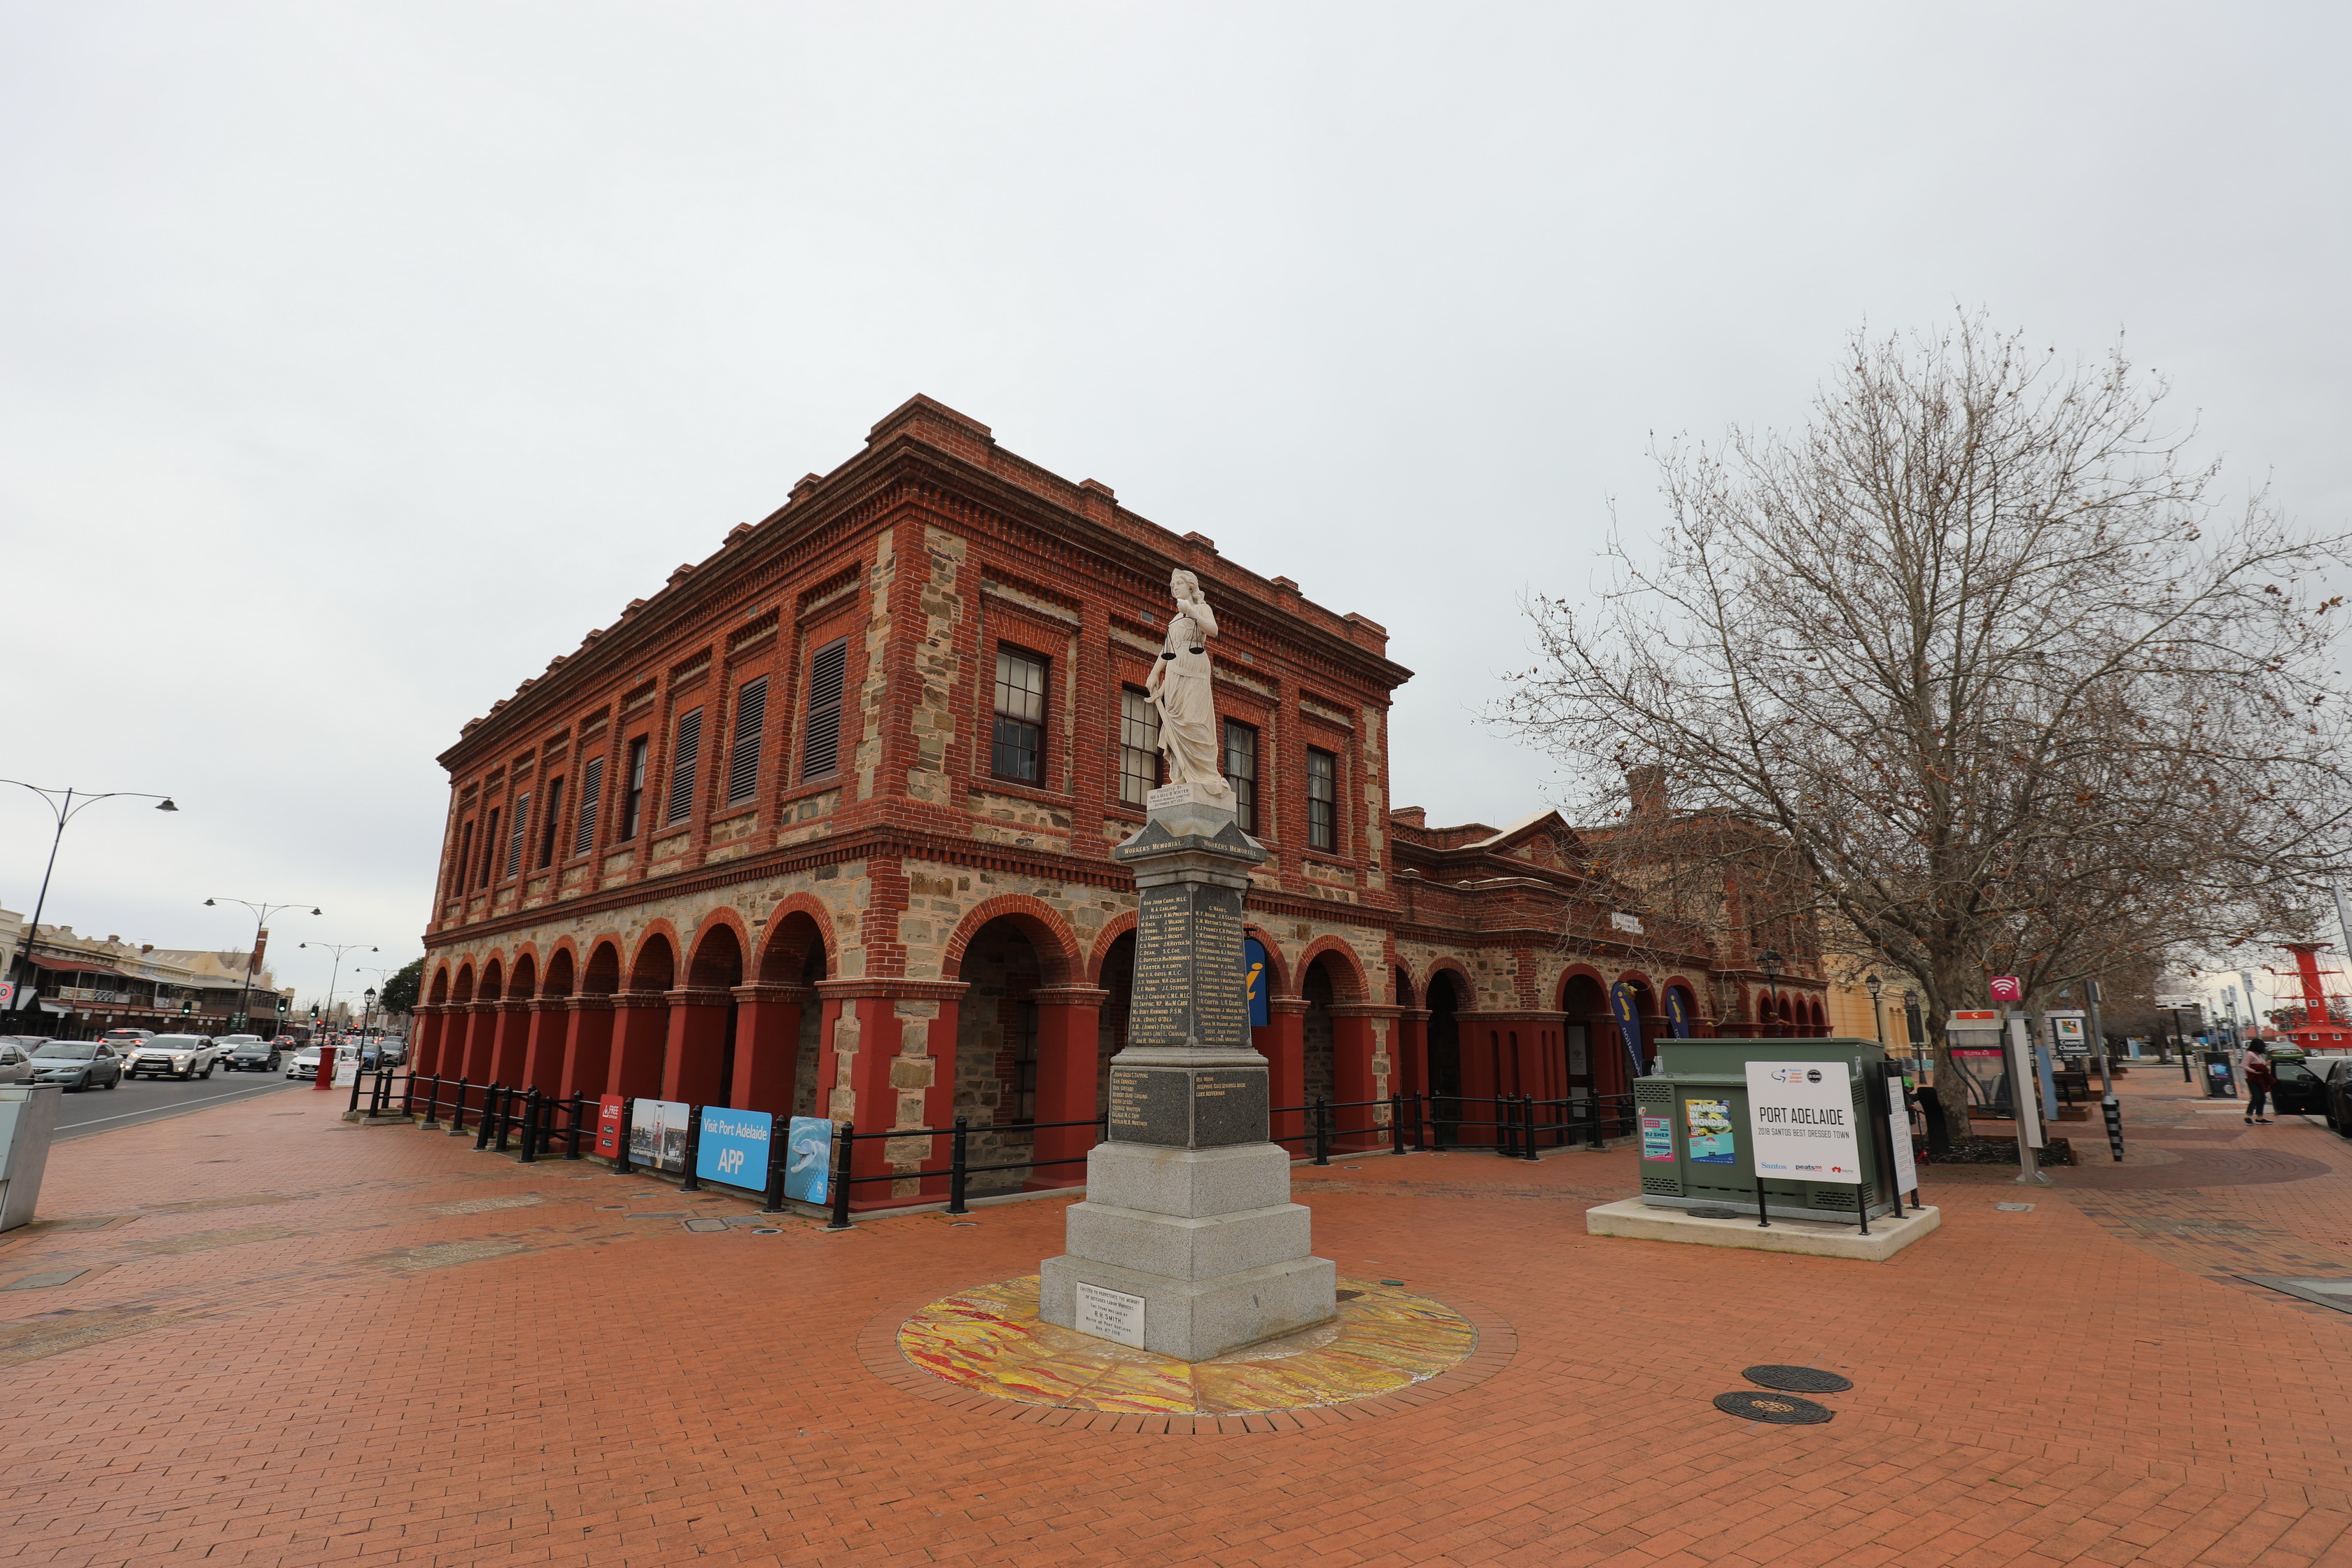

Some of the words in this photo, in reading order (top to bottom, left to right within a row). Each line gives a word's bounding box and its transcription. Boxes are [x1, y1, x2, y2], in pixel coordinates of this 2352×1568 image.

[1203, 839, 1228, 850] WORKERS
[609, 1105, 619, 1115] FREE
[1688, 1105, 1728, 1113] WANDER
[1760, 1107, 1786, 1123] PORT
[1791, 1108, 1844, 1125] ADELAIDE
[1690, 1119, 1730, 1127] WONDER
[704, 1118, 718, 1133] Visit
[719, 1120, 735, 1135] Port
[735, 1122, 767, 1140] Adelaide
[1771, 1128, 1791, 1136] SANTOS
[1793, 1128, 1806, 1137] BEST
[1808, 1130, 1831, 1138] DRESSED
[1833, 1130, 1849, 1139] TOWN
[717, 1148, 744, 1175] APP
[1098, 1291, 1118, 1300] PERPETUATE
